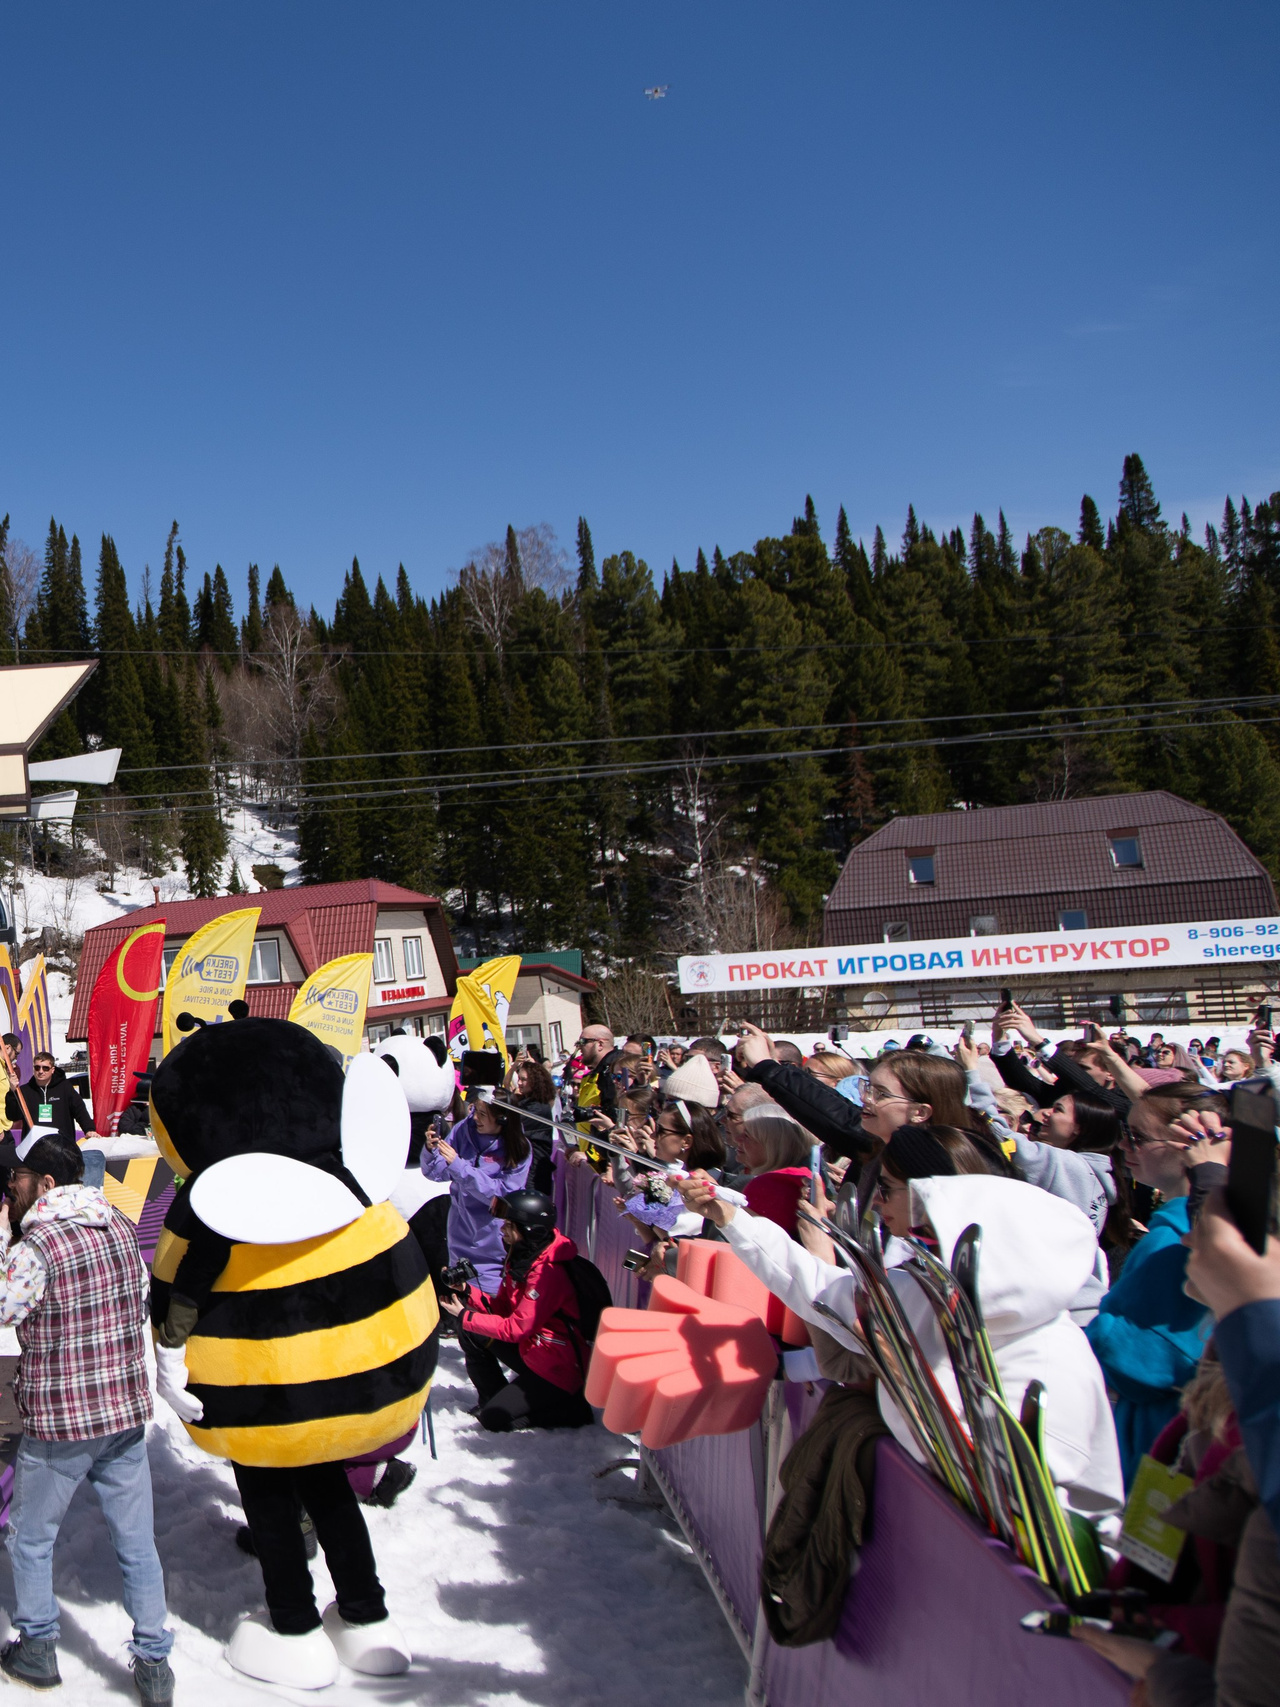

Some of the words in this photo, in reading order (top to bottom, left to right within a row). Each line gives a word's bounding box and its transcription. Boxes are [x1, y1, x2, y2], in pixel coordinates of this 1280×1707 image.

[728, 959, 829, 982] ПРОКАТ
[837, 950, 964, 976] ИГРОВАЯ
[971, 937, 1171, 968] ИНСТРУКТОР
[109, 1044, 118, 1065] RIDE
[119, 1021, 128, 1064] FESTIVAL
[111, 1066, 119, 1074] &
[117, 1064, 126, 1094] MUSIC
[111, 1076, 119, 1094] SUN
